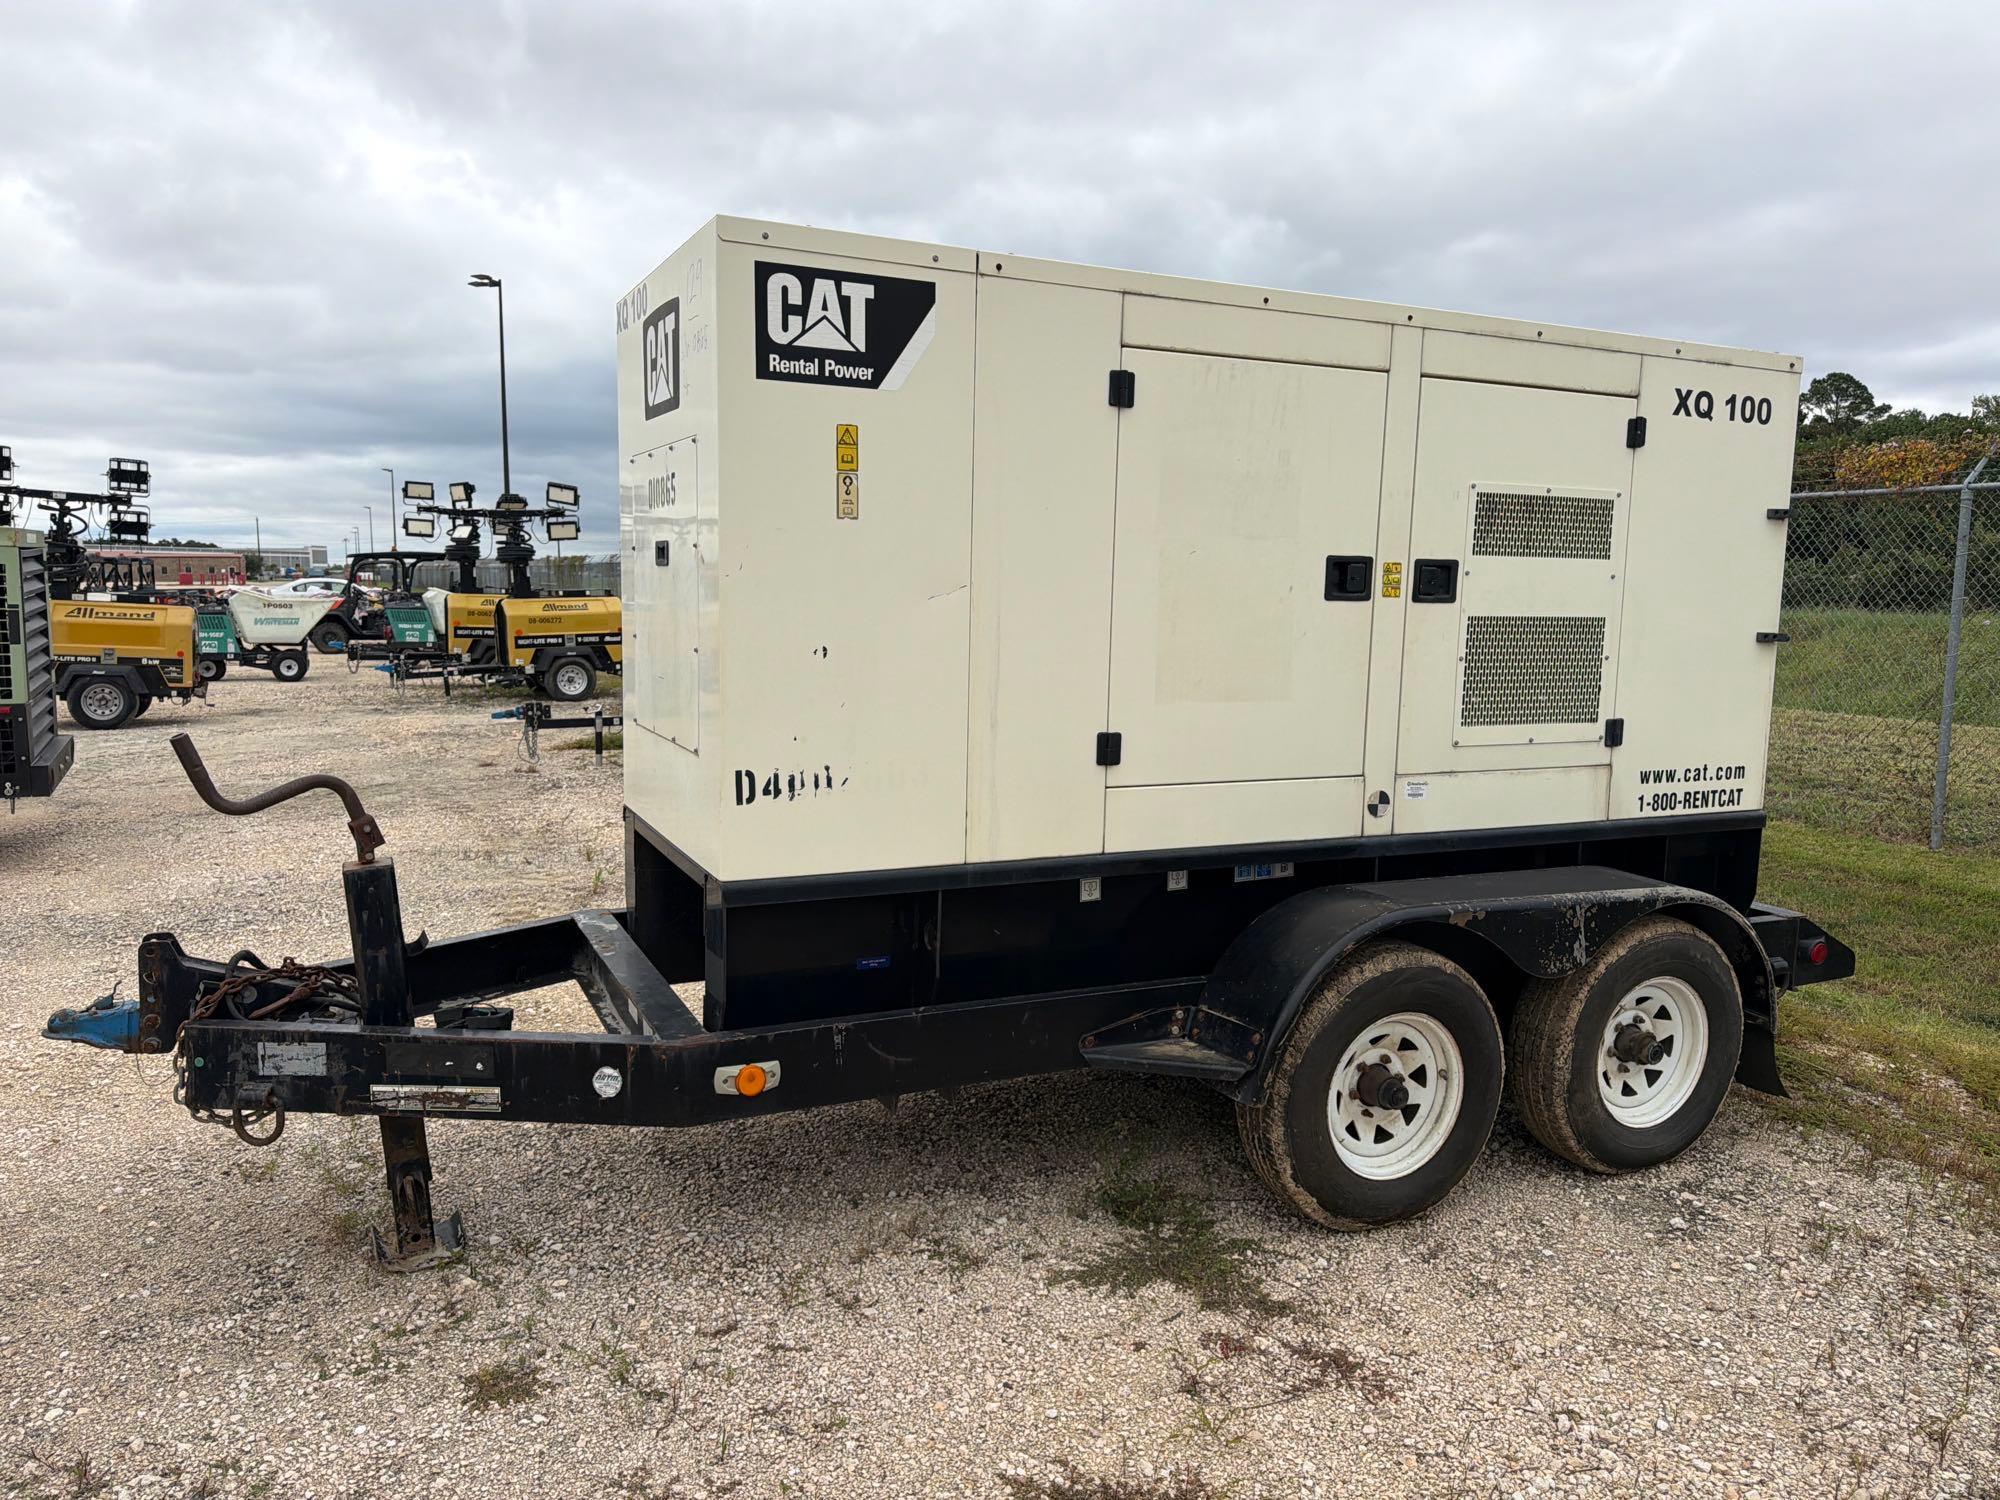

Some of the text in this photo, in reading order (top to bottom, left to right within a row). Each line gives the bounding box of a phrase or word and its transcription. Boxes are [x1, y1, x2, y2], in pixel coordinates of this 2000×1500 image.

[616, 282, 648, 335] XQ 100
[767, 272, 875, 353] CAT
[646, 311, 676, 407] CAT
[769, 354, 874, 381] Rental Power
[1672, 388, 1772, 425] XQ 100
[64, 607, 156, 621] Allmand
[542, 603, 589, 612] Allmand
[1640, 764, 1746, 785] www.cat.com
[1638, 788, 1744, 812] 1-800-RENTCAT
